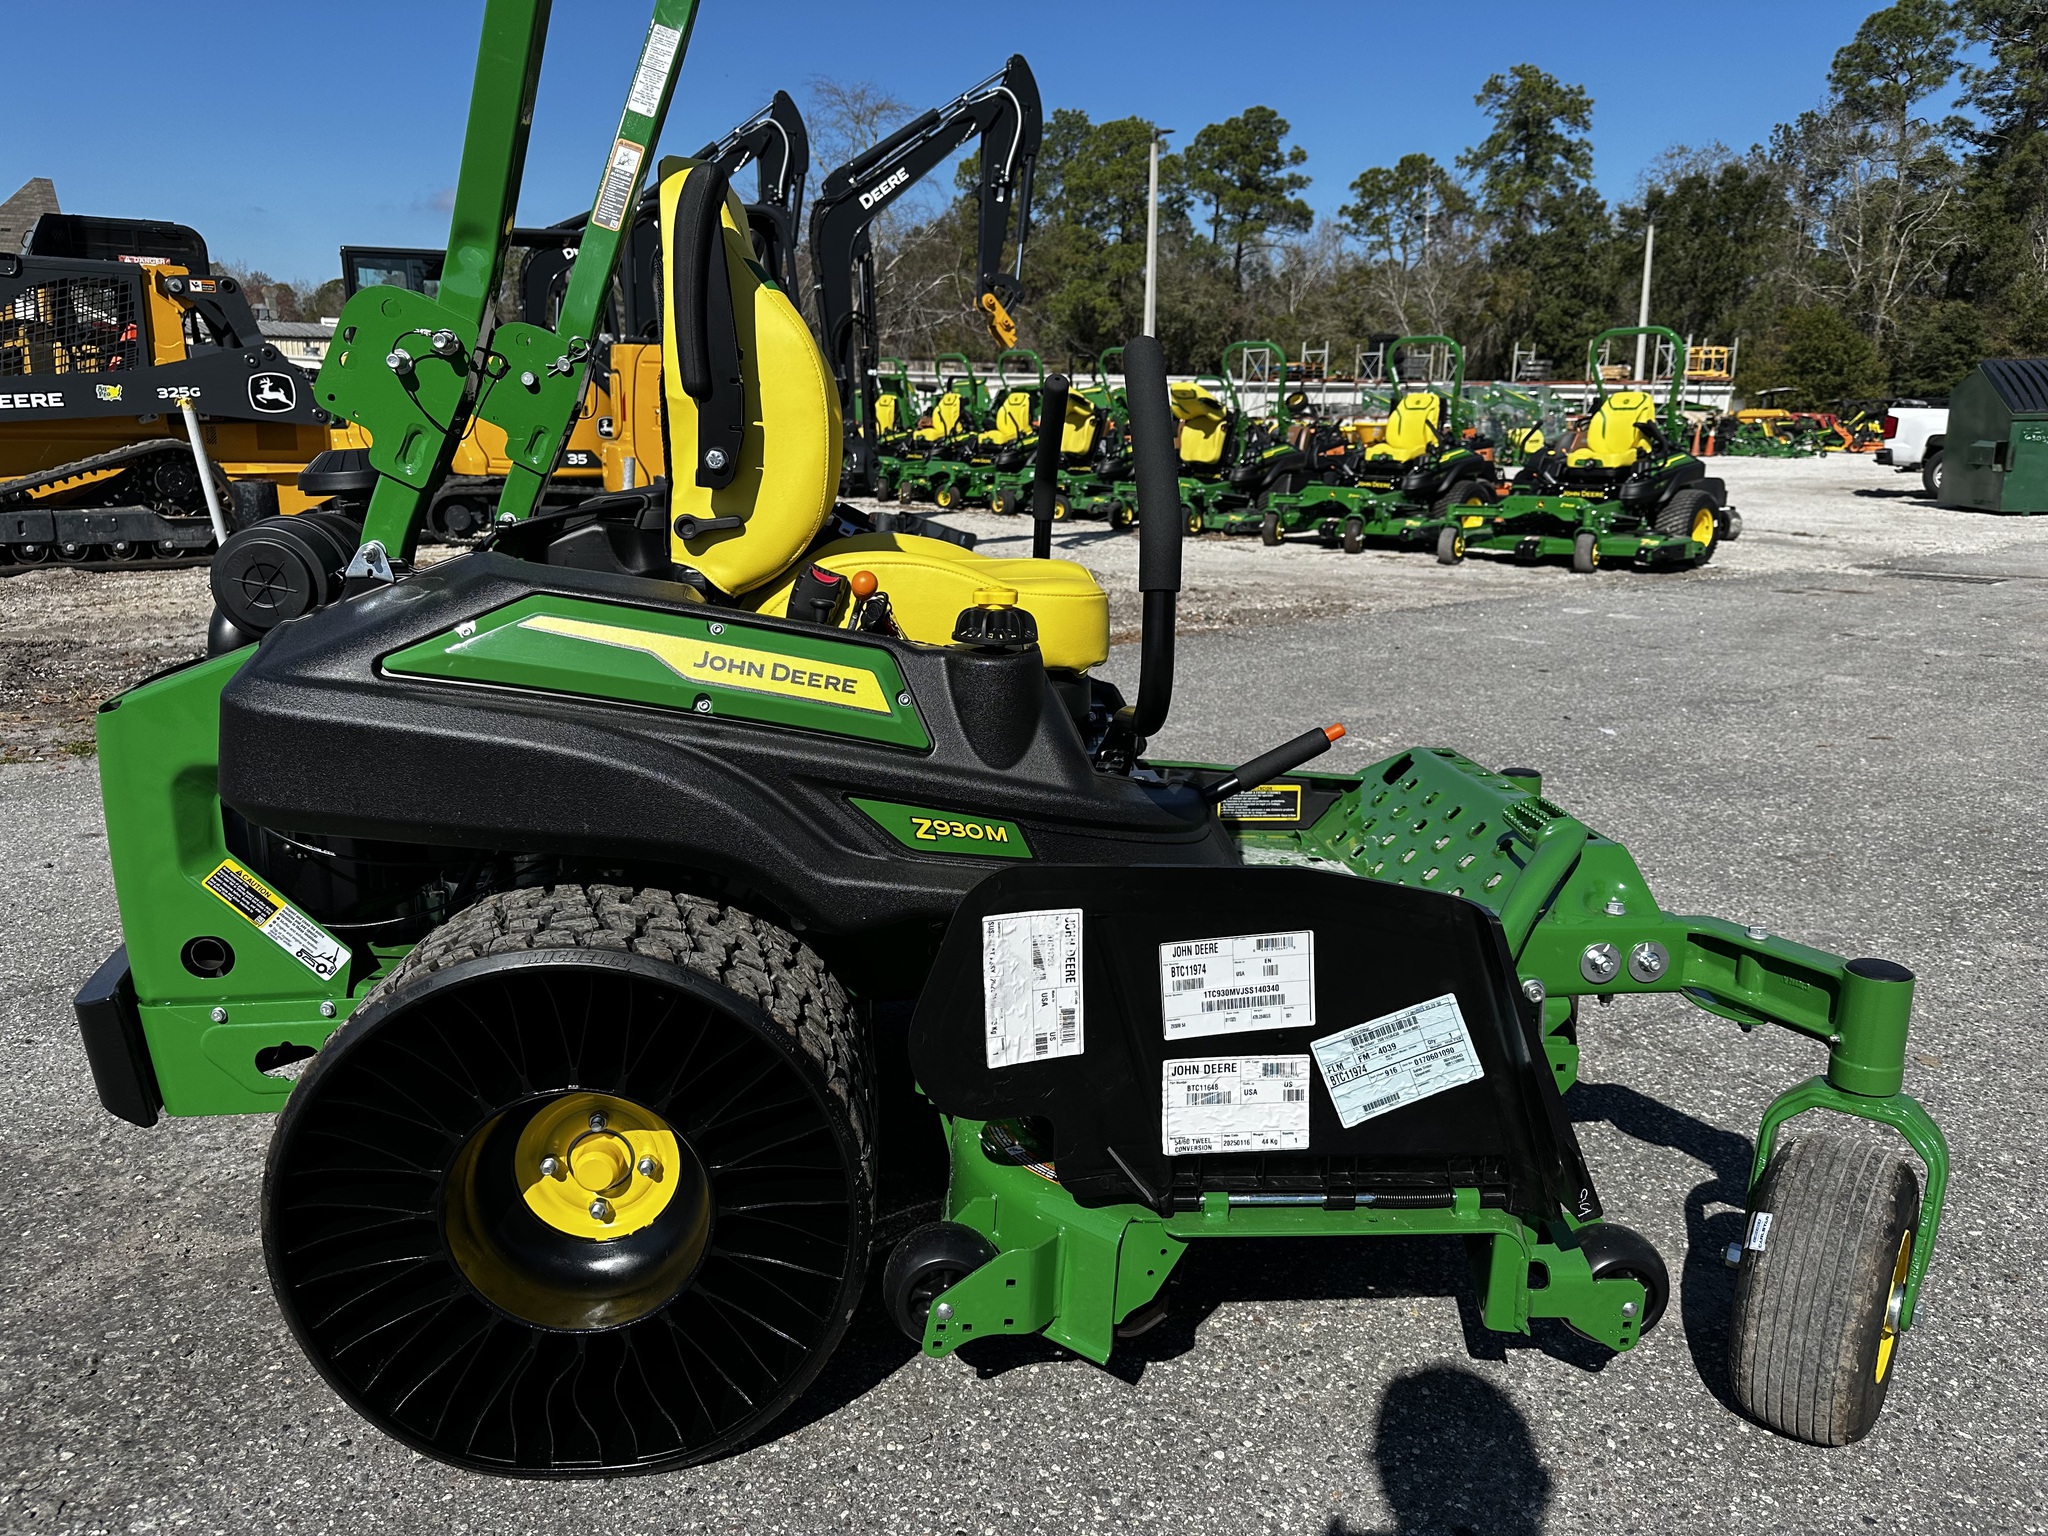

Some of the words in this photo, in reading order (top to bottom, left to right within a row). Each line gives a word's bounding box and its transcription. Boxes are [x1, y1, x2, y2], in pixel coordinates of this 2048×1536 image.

[858, 167, 910, 211] DEERE
[133, 257, 165, 265] DANGER
[157, 386, 201, 398] 325G
[567, 454, 588, 464] 35
[1581, 490, 1604, 498] DEERE
[693, 651, 764, 679] JOHN
[771, 663, 858, 694] DEERE
[242, 873, 272, 898] CAUTION
[1172, 944, 1192, 958] JOHN
[1195, 942, 1219, 955] DEERE
[523, 950, 632, 968] MICHELIN
[1171, 964, 1206, 978] BTC11974
[1204, 984, 1280, 998] 1TC930MVJSS140340
[1050, 1032, 1056, 1041] US
[1413, 1046, 1455, 1066] 0170601090
[1172, 1065, 1199, 1076] JOHN
[1204, 1063, 1237, 1074] DEERE
[1327, 1062, 1344, 1074] FLM
[1384, 1066, 1398, 1076] 916
[1330, 1064, 1368, 1086] BTC11974
[1187, 1084, 1219, 1092] BTC11648
